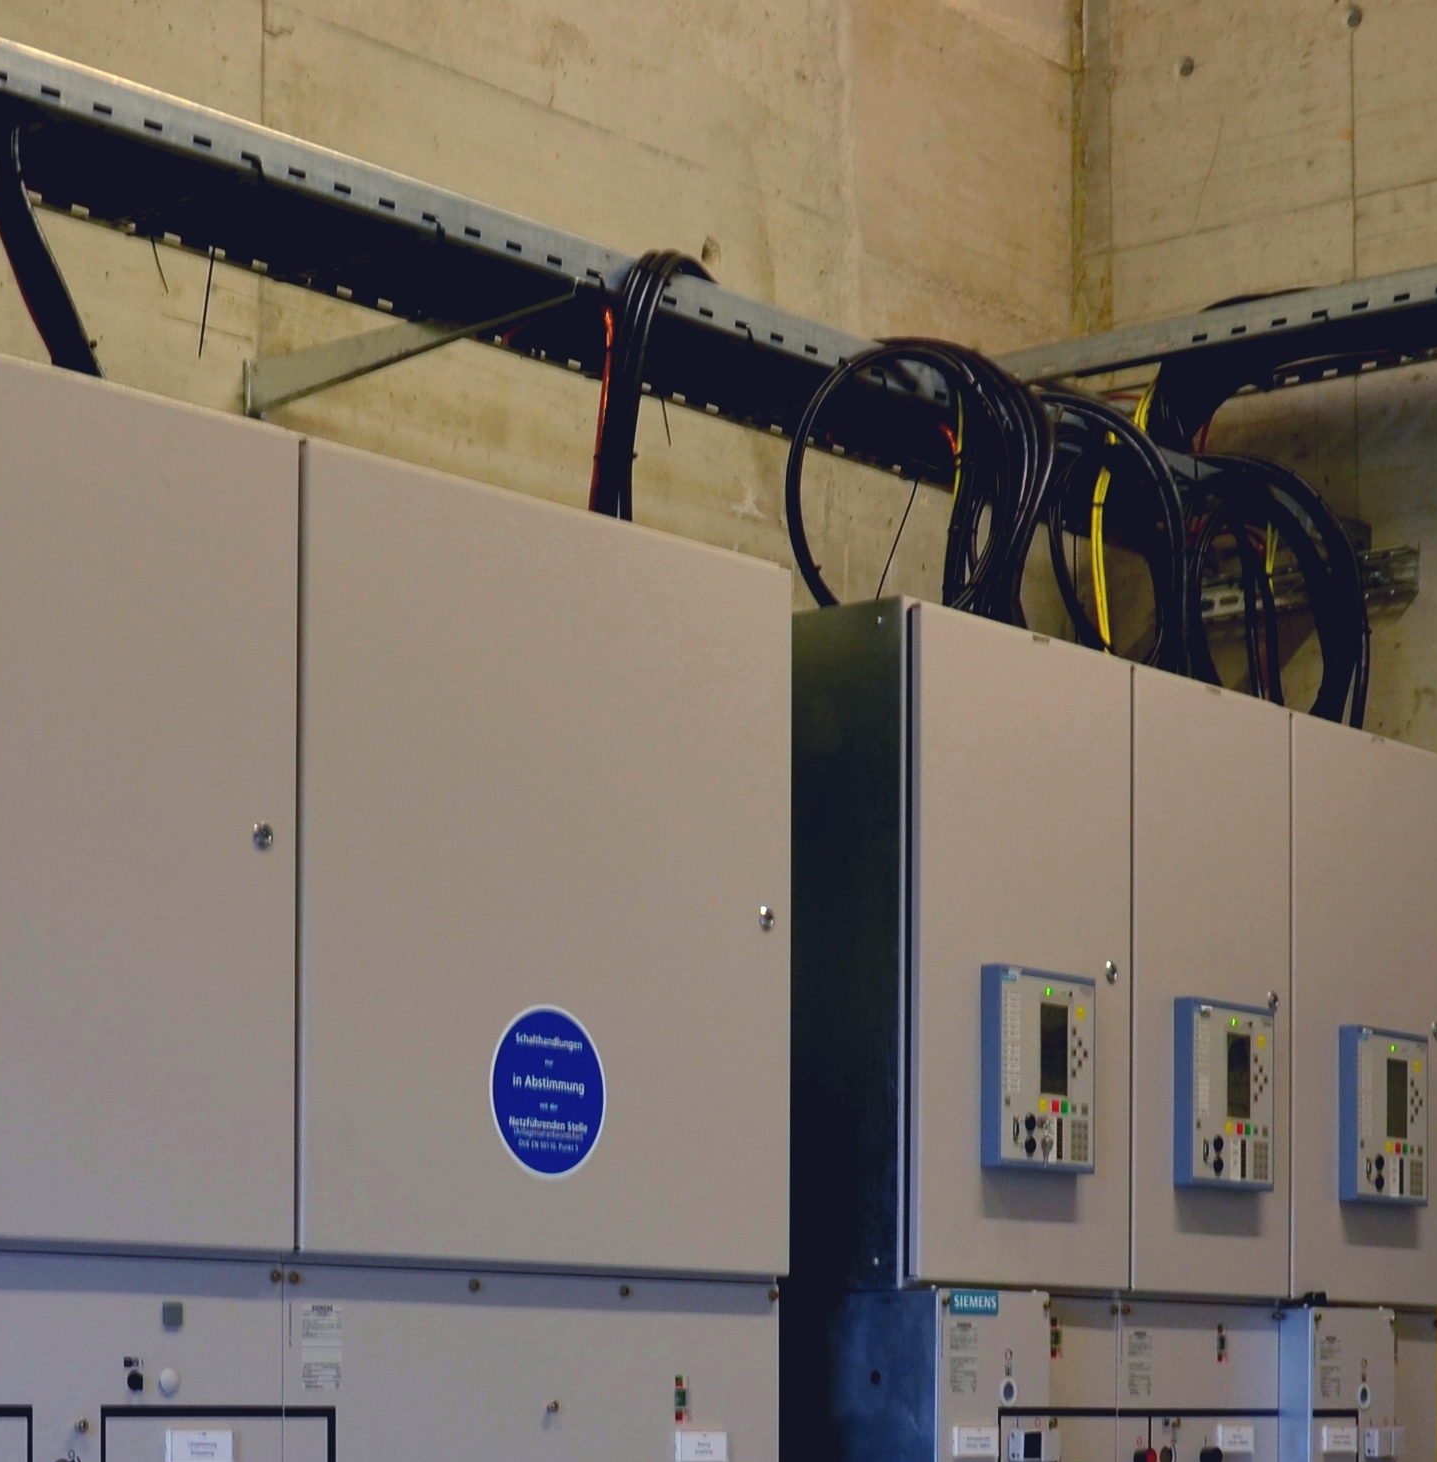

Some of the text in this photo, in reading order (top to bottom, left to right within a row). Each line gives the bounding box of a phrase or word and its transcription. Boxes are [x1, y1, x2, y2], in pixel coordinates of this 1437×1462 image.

[515, 1032, 583, 1052] Schalthandlungen
[513, 1073, 522, 1087] in
[524, 1075, 585, 1096] Abstimmung
[954, 1294, 997, 1310] SIEMENS
